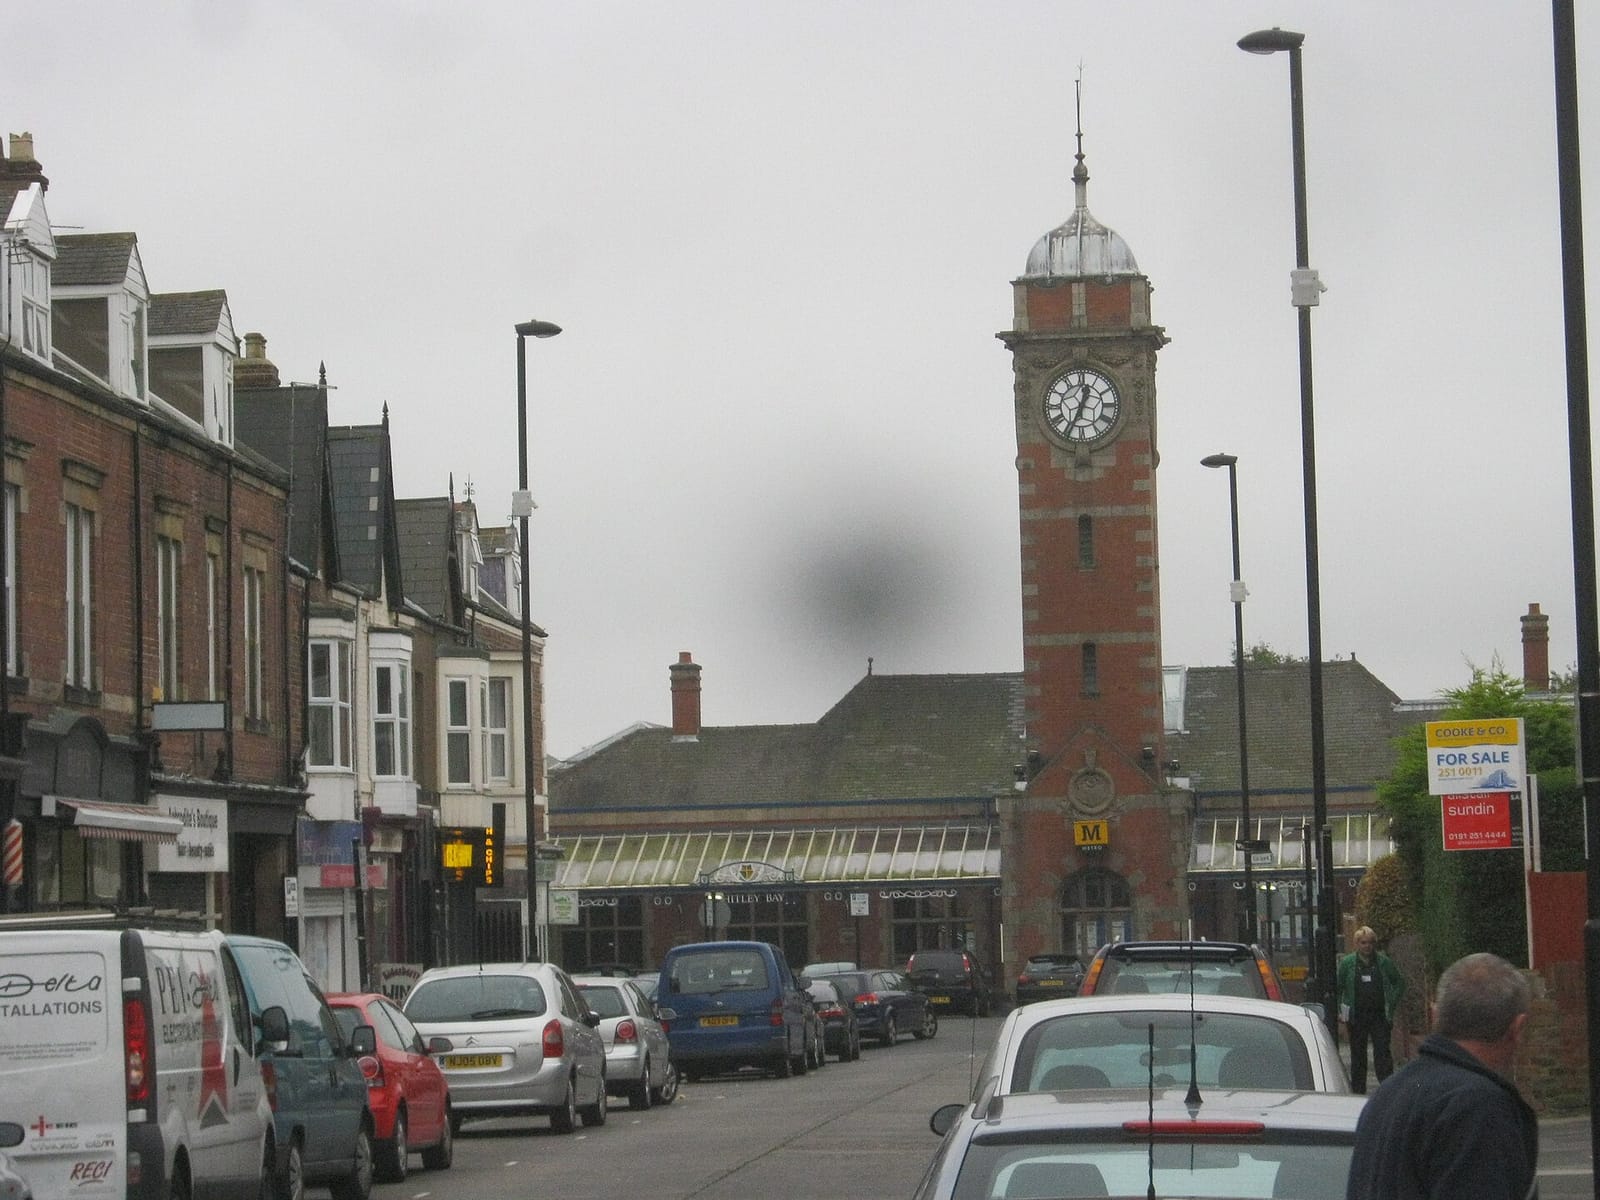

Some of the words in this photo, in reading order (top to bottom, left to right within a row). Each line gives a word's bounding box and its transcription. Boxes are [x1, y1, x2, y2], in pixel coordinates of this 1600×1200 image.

[1435, 727, 1474, 738] COOKE
[1477, 726, 1486, 736] &
[1488, 726, 1508, 736] CO.
[1437, 753, 1467, 766] FOR
[1471, 751, 1509, 765] SALE
[1438, 767, 1456, 777] 251
[1459, 767, 1482, 776] 0011
[1448, 802, 1495, 816] sundin
[1081, 824, 1101, 841] M
[1449, 832, 1467, 840] 0191
[727, 894, 760, 904] HITLEY
[766, 893, 784, 903] BAY
